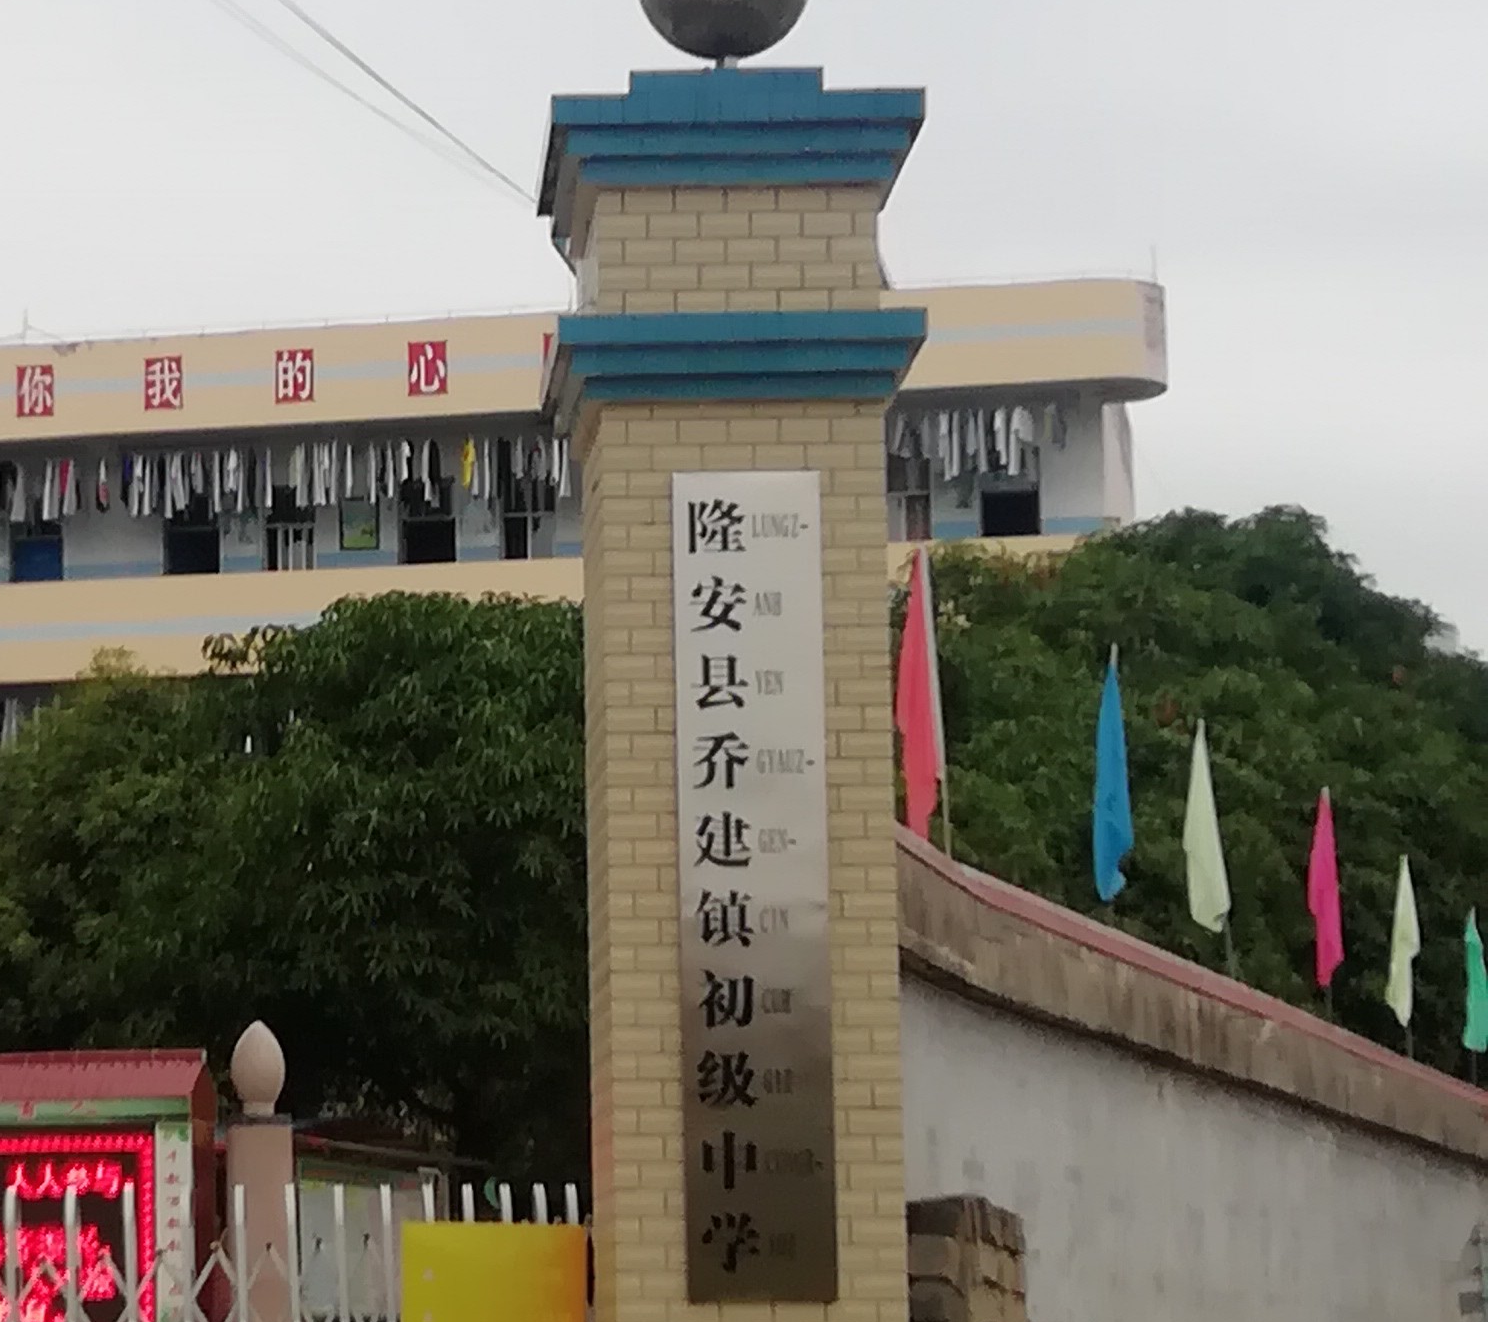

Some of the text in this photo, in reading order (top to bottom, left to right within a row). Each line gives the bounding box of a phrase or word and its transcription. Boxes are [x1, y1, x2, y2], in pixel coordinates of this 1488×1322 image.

[686, 498, 761, 1273] 隆安县乔建镇初级中学
